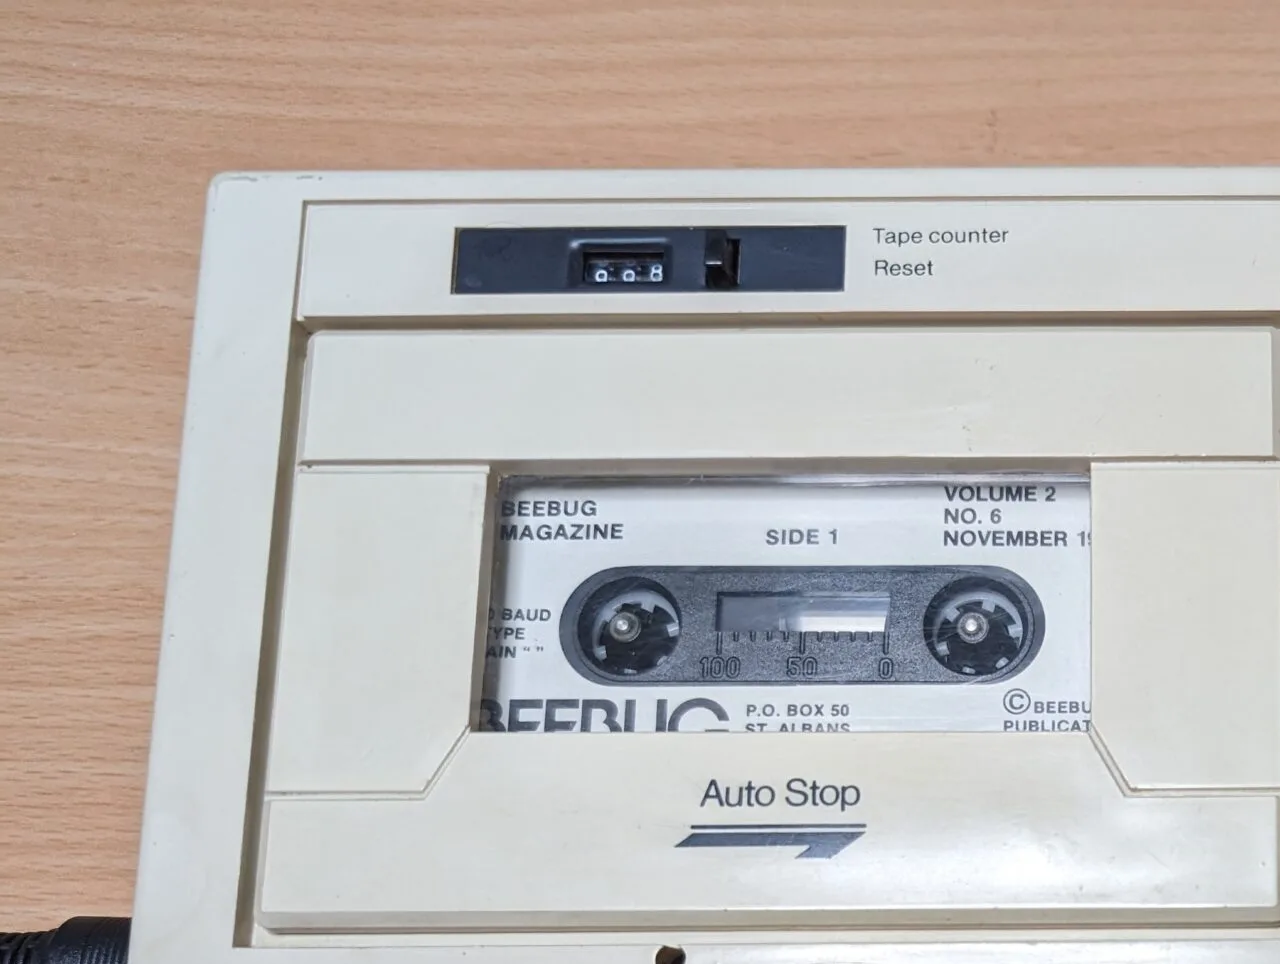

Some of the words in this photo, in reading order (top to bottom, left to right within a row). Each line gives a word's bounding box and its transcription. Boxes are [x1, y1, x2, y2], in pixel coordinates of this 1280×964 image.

[873, 227, 923, 247] Tape
[928, 228, 1009, 244] counter
[874, 259, 933, 276] Reset
[944, 486, 1038, 502] VOLUME
[1044, 486, 1057, 502] 2
[501, 500, 598, 517] BEEBUG
[944, 508, 983, 525] NO.
[990, 508, 1002, 524] 6
[501, 524, 624, 541] MAGAZINE
[766, 529, 820, 545] SIDE
[828, 529, 838, 545] 1
[943, 530, 1068, 547] NOVEMBER
[502, 608, 552, 622] BAUD
[699, 656, 741, 679] 100
[786, 656, 818, 678] 50
[878, 656, 894, 680] 0
[746, 704, 780, 717] P.O.
[787, 704, 824, 717] BOX
[830, 704, 849, 717] 50
[700, 779, 776, 808] Auto
[784, 778, 861, 812] Stop
